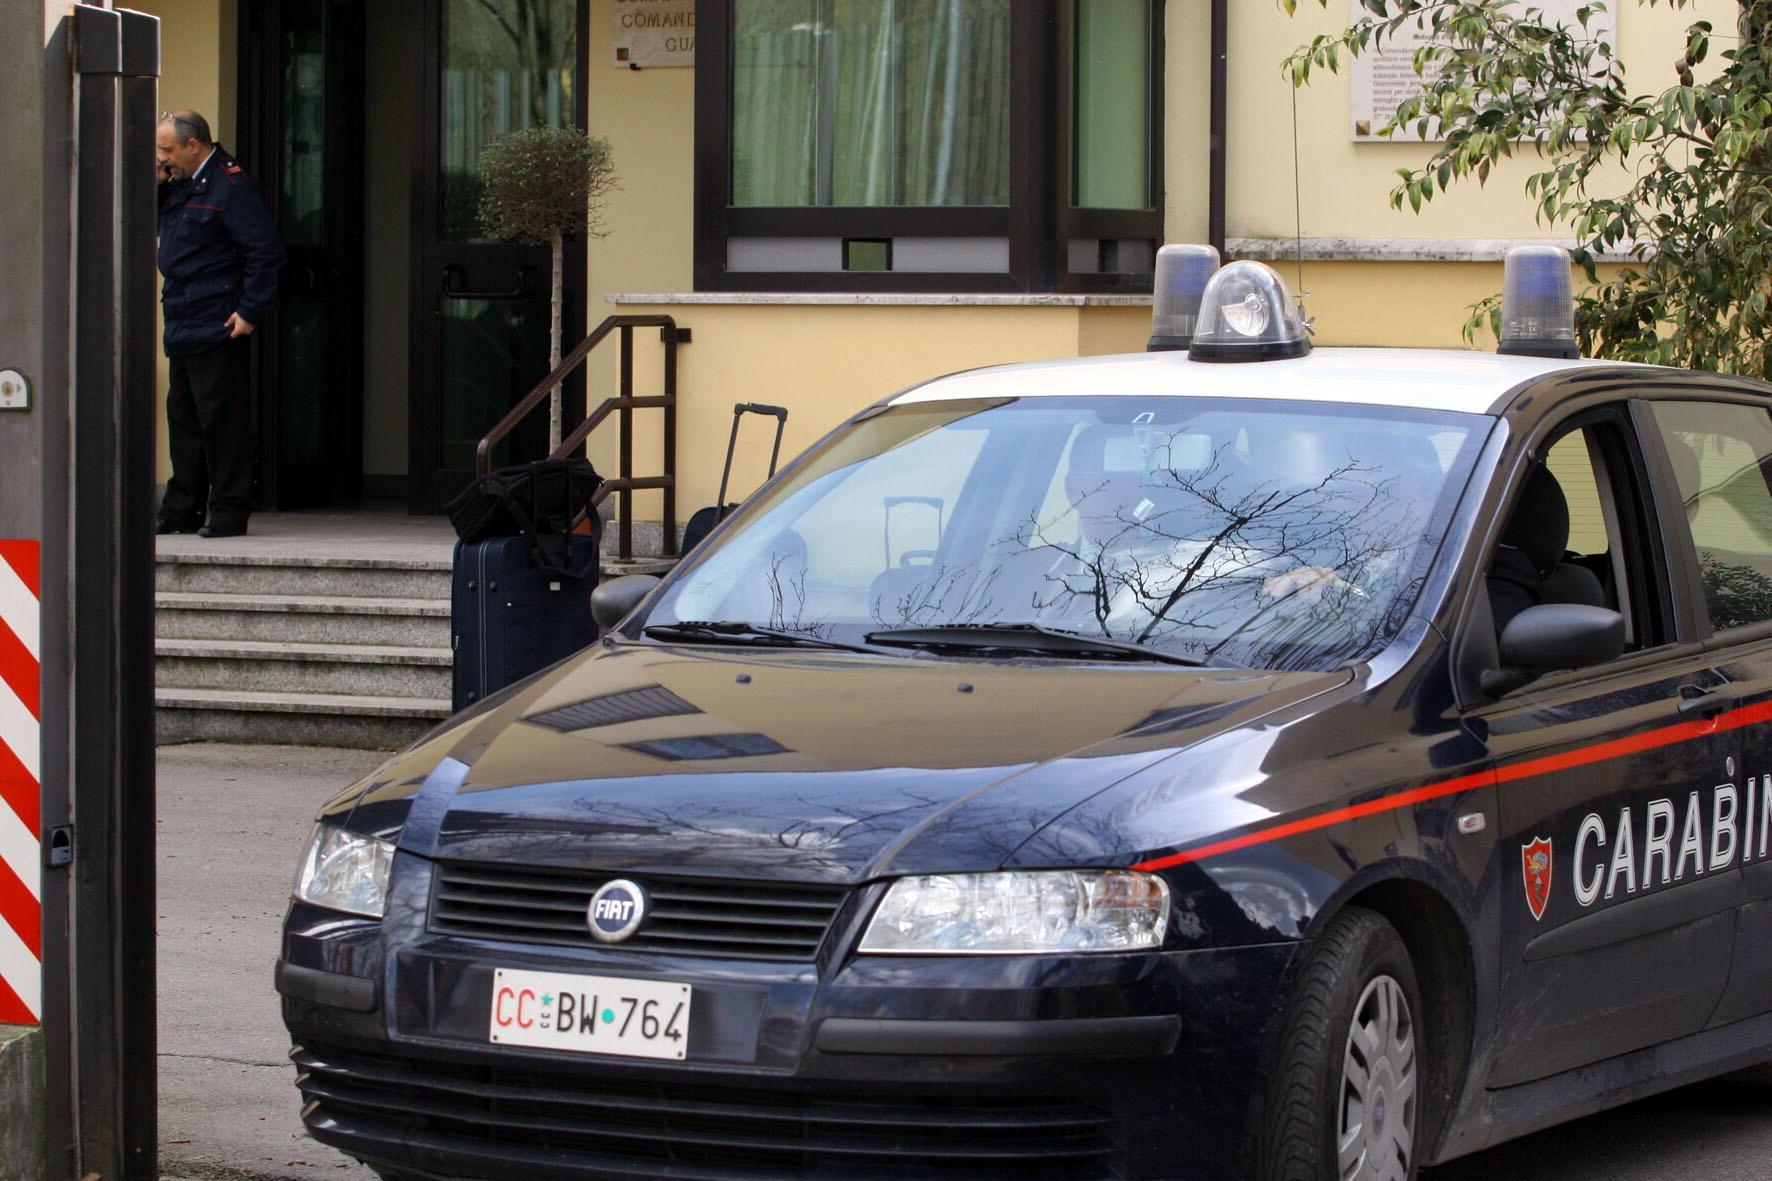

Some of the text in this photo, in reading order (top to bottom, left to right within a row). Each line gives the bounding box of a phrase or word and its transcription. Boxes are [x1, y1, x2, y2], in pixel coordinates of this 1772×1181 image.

[595, 899, 634, 920] FIAT
[496, 987, 684, 1042] CC BW 764
